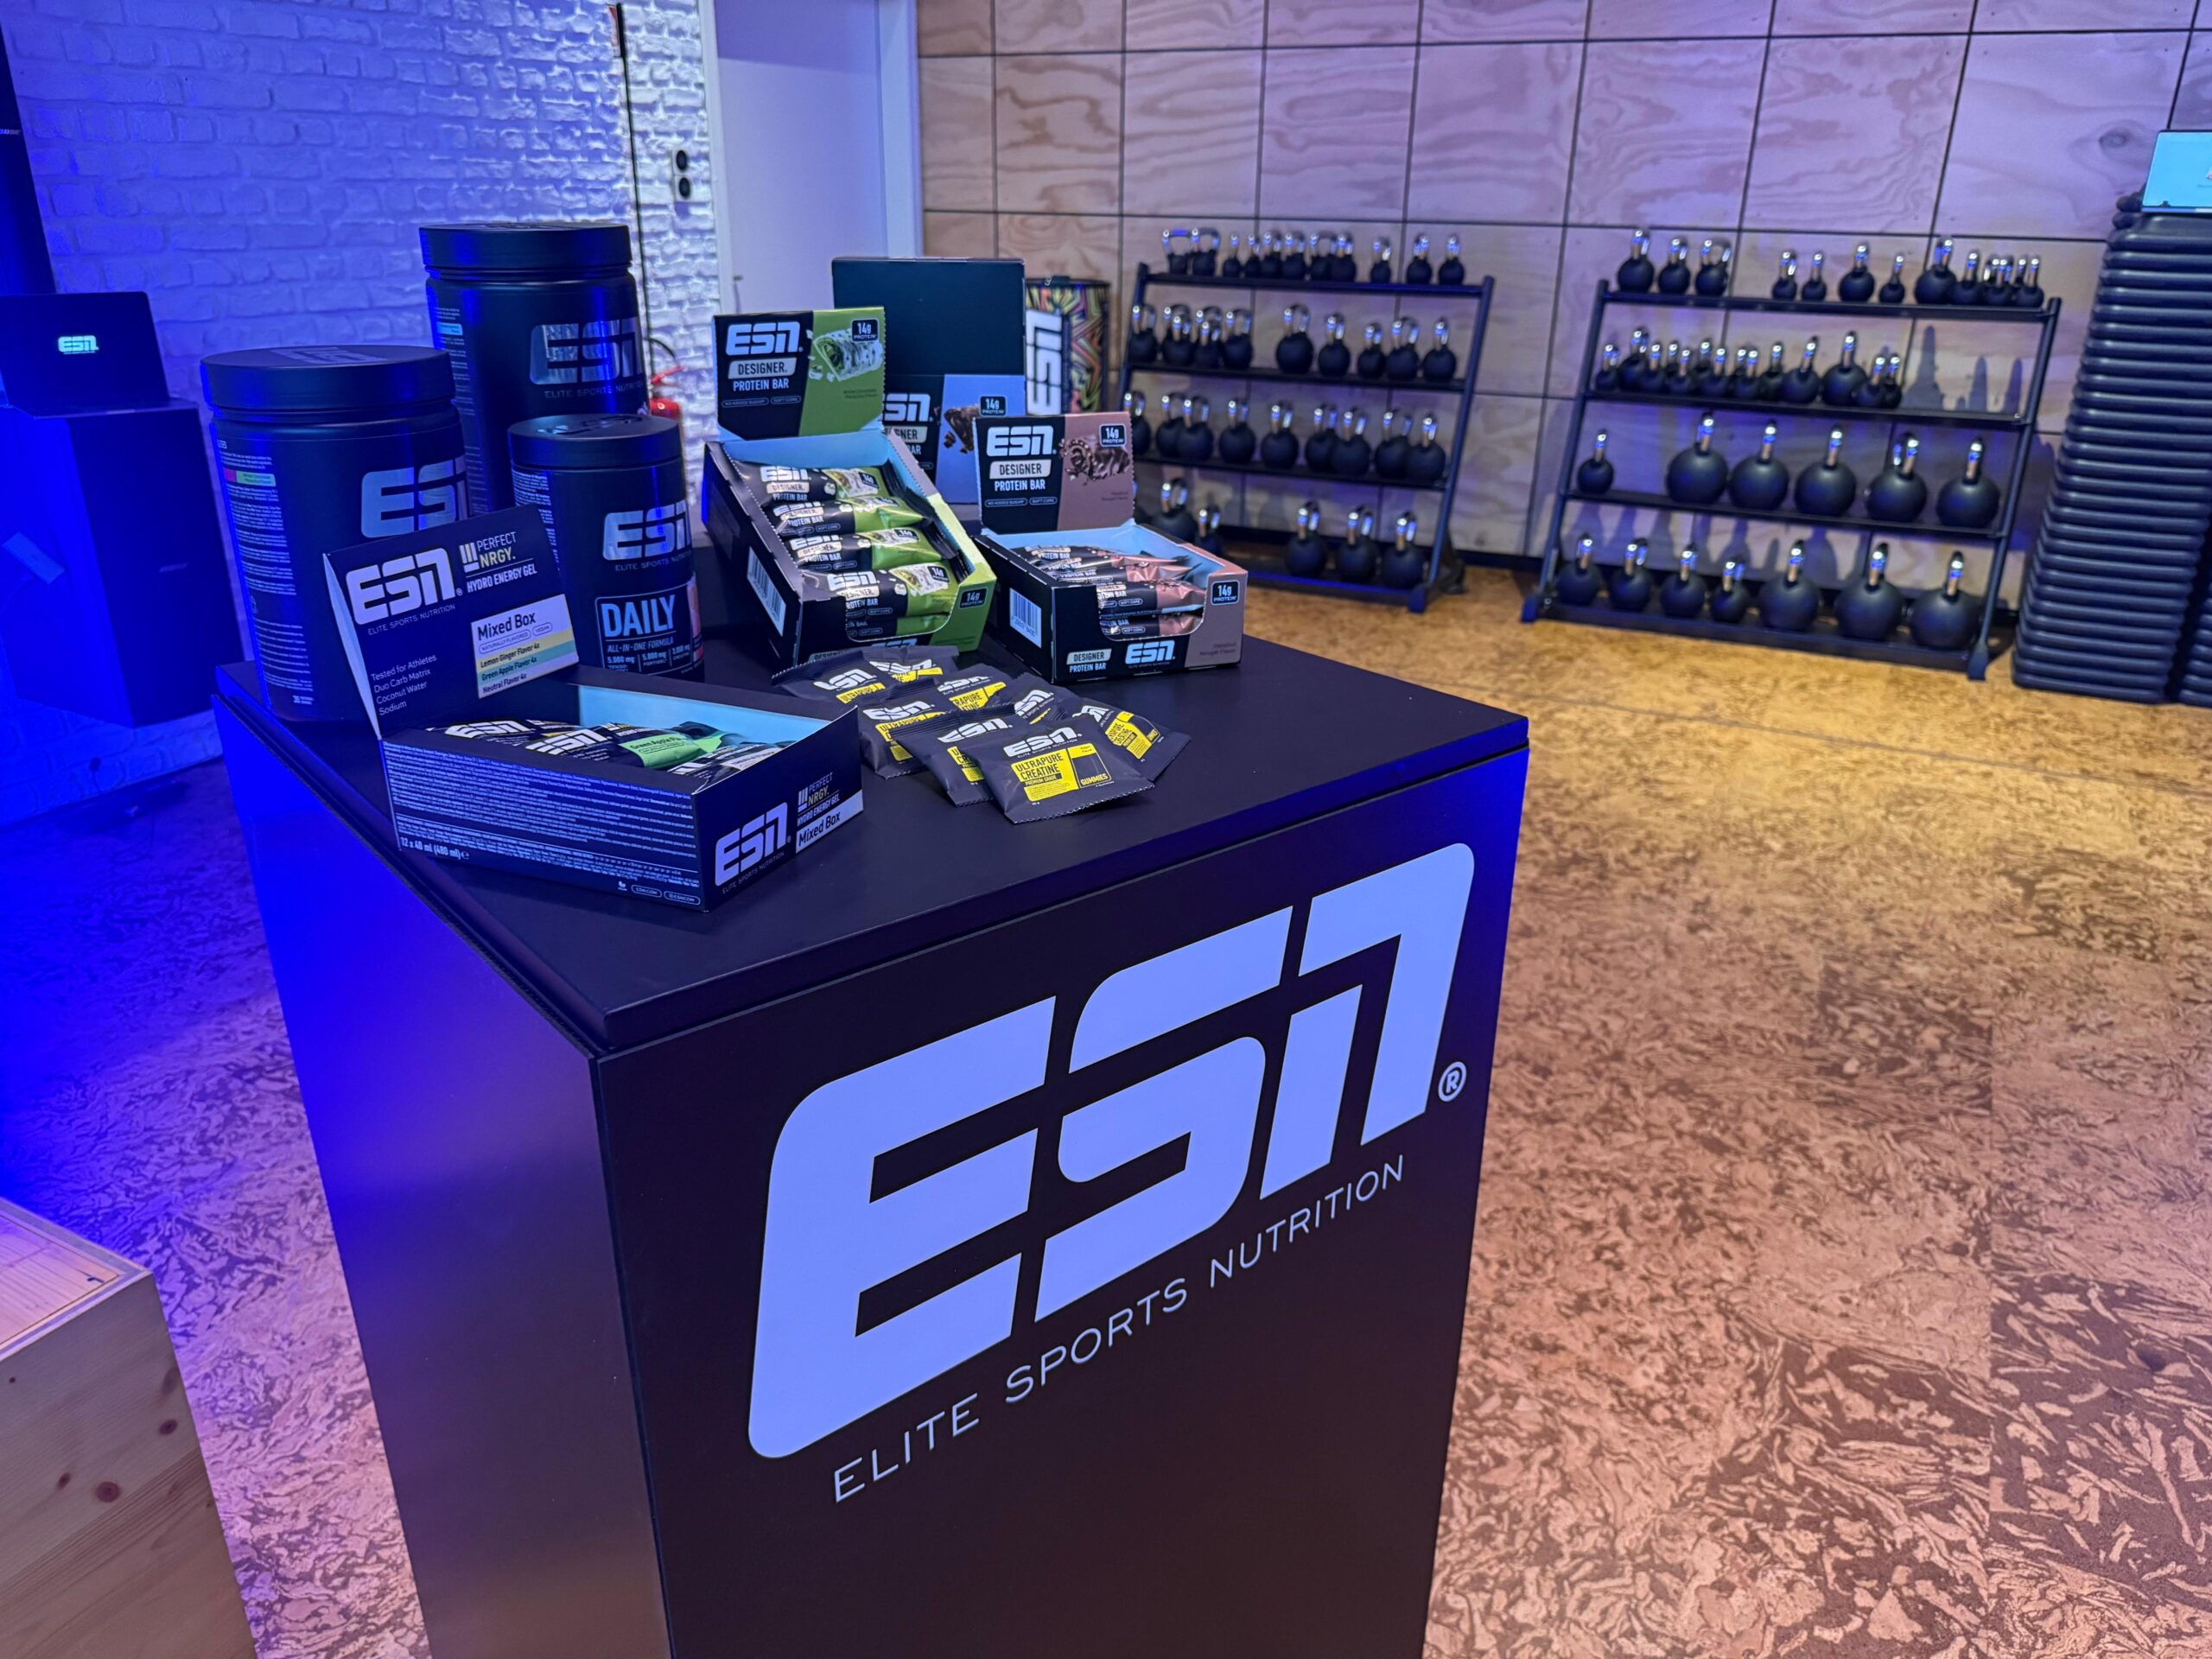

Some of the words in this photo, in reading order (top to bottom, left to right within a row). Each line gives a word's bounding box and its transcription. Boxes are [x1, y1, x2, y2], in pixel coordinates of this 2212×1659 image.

[857, 322, 872, 335] 14g
[733, 379, 770, 392] PROTEIN
[772, 378, 790, 390] BAR
[985, 398, 1000, 410] 14g
[1105, 428, 1120, 439] 14g
[999, 464, 1042, 476] DESIGNER
[995, 480, 1028, 492] PROTEIN
[1030, 479, 1046, 491] BAR
[476, 531, 517, 552] PERFECT
[479, 546, 517, 568] NRGY.
[467, 575, 493, 594] HYDRO
[493, 567, 522, 586] ENERGY
[523, 563, 538, 576] GEL
[967, 592, 980, 602] 14g
[1217, 585, 1232, 596] 14g
[846, 599, 866, 610] ROTEIN
[367, 624, 389, 635] ELITE
[390, 614, 419, 630] SPORTS
[420, 603, 456, 620] NUTRITION
[601, 594, 675, 637] DAILY
[477, 616, 512, 641] Mixed
[514, 613, 537, 629] Box
[480, 657, 499, 668] Lemon
[517, 646, 533, 657] Flavor
[1073, 652, 1105, 662] DESIGNER
[371, 666, 397, 682] Tested
[397, 664, 408, 674] for
[408, 654, 437, 670] Athletes
[481, 671, 499, 681] Green
[514, 659, 531, 670] Flavor
[1069, 664, 1094, 673] PROTEIN
[1095, 662, 1107, 671] BAR
[373, 683, 391, 694] Duo
[390, 676, 409, 688] Carb
[409, 669, 432, 682] Matrix
[482, 681, 504, 694] Neutral
[504, 677, 520, 686] Flavor
[376, 688, 406, 704] Coconut
[406, 681, 428, 694] Water
[378, 701, 407, 715] Sodium
[1015, 753, 1064, 772] ULTRAPURE
[1020, 763, 1061, 781] CREATINE
[1080, 772, 1109, 786] GUMMIES
[809, 772, 834, 793] PERFECT
[798, 819, 824, 847] Mixed
[825, 811, 841, 830] Box
[400, 836, 409, 847] 12
[834, 1392, 980, 1503] ELITE
[1005, 1276, 1188, 1404] SPORTS
[1210, 1154, 1404, 1288] NUTRITION
